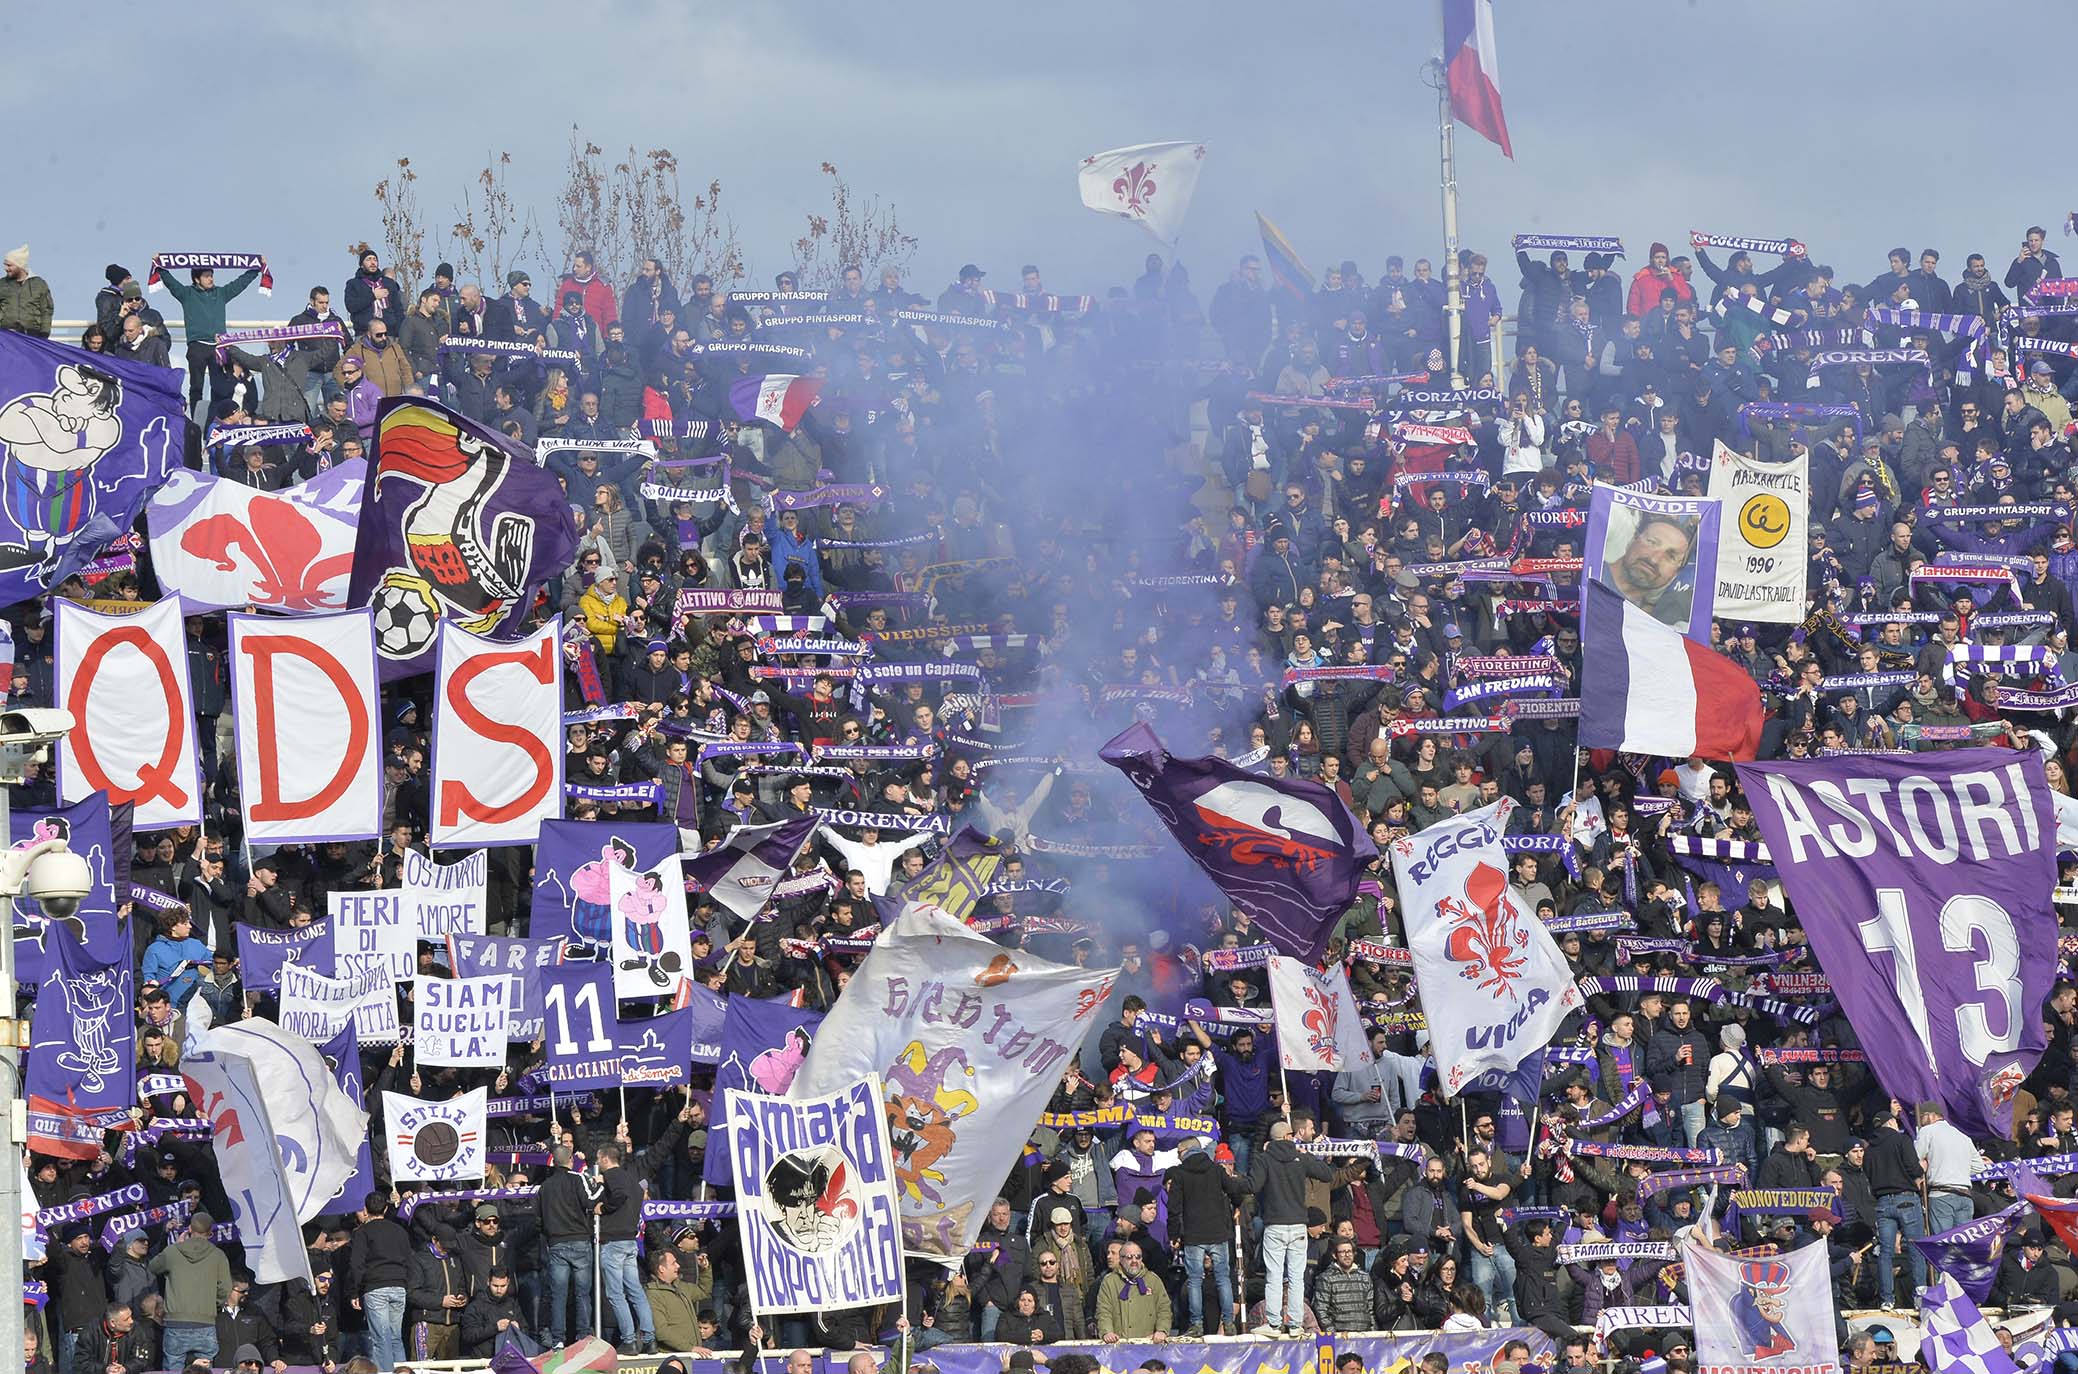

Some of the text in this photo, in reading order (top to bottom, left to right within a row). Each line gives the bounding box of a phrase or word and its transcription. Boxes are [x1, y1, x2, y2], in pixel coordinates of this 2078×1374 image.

[1709, 235, 1788, 254] COLLETTIVO
[160, 254, 261, 268] FIORENTINA
[732, 291, 828, 301] GRUPPO PINTASPORT
[765, 314, 862, 328] GRUPPO PINTASPORT
[899, 311, 998, 329] GRUPPO PINTASPORT
[445, 337, 485, 350] GRUPPO
[708, 342, 804, 357] GRUPPO PINTASPORT
[657, 485, 726, 501] COLLETTIVO
[1613, 491, 1699, 513] DAVIDE
[1944, 504, 2051, 516] GRUPPO PINTASPORT
[1745, 555, 1775, 574] 1990
[1853, 612, 1940, 623] ACF FIORENTINA
[878, 623, 989, 641] VIEUSSEUX
[776, 639, 802, 651] CIAO
[874, 667, 903, 677] solo
[905, 665, 922, 676] un
[1473, 658, 1552, 671] FIORENTINA
[1823, 676, 1848, 688] ACF
[1456, 684, 1481, 701] SAN
[68, 625, 555, 826] Q D S
[1414, 718, 1489, 731] COLLETTIVO
[828, 747, 865, 758] VINCI
[866, 748, 894, 758] PER
[816, 808, 945, 833] FIORENZA
[1765, 764, 2040, 865] ASTORI
[407, 852, 486, 890] OSTINATO
[739, 877, 773, 888] VIOLA
[131, 887, 147, 899] di
[339, 896, 400, 927] FIERI
[416, 903, 477, 937] AMORE
[250, 922, 328, 946] QUESTIONE
[360, 929, 378, 952] DI
[286, 947, 303, 963] DI
[457, 940, 553, 970] FARE
[287, 970, 330, 1002] VIVI
[1858, 888, 2025, 1079] 13
[426, 981, 503, 1009] SIAM
[281, 1009, 329, 1040] ONORA
[420, 1009, 505, 1034] QUELLI
[544, 981, 613, 1056] 11
[1464, 986, 1551, 1051] VIOLA
[1779, 1049, 1837, 1062] JUVE TI
[549, 1057, 621, 1082] CALCIANTI
[637, 1064, 683, 1083] Sempre
[515, 1095, 529, 1109] di
[400, 1105, 468, 1131] STILE
[406, 1145, 476, 1182] DI VITA
[1606, 1148, 1682, 1161] FIORENTINA
[1574, 1243, 1665, 1256] FAMMI GODERE
